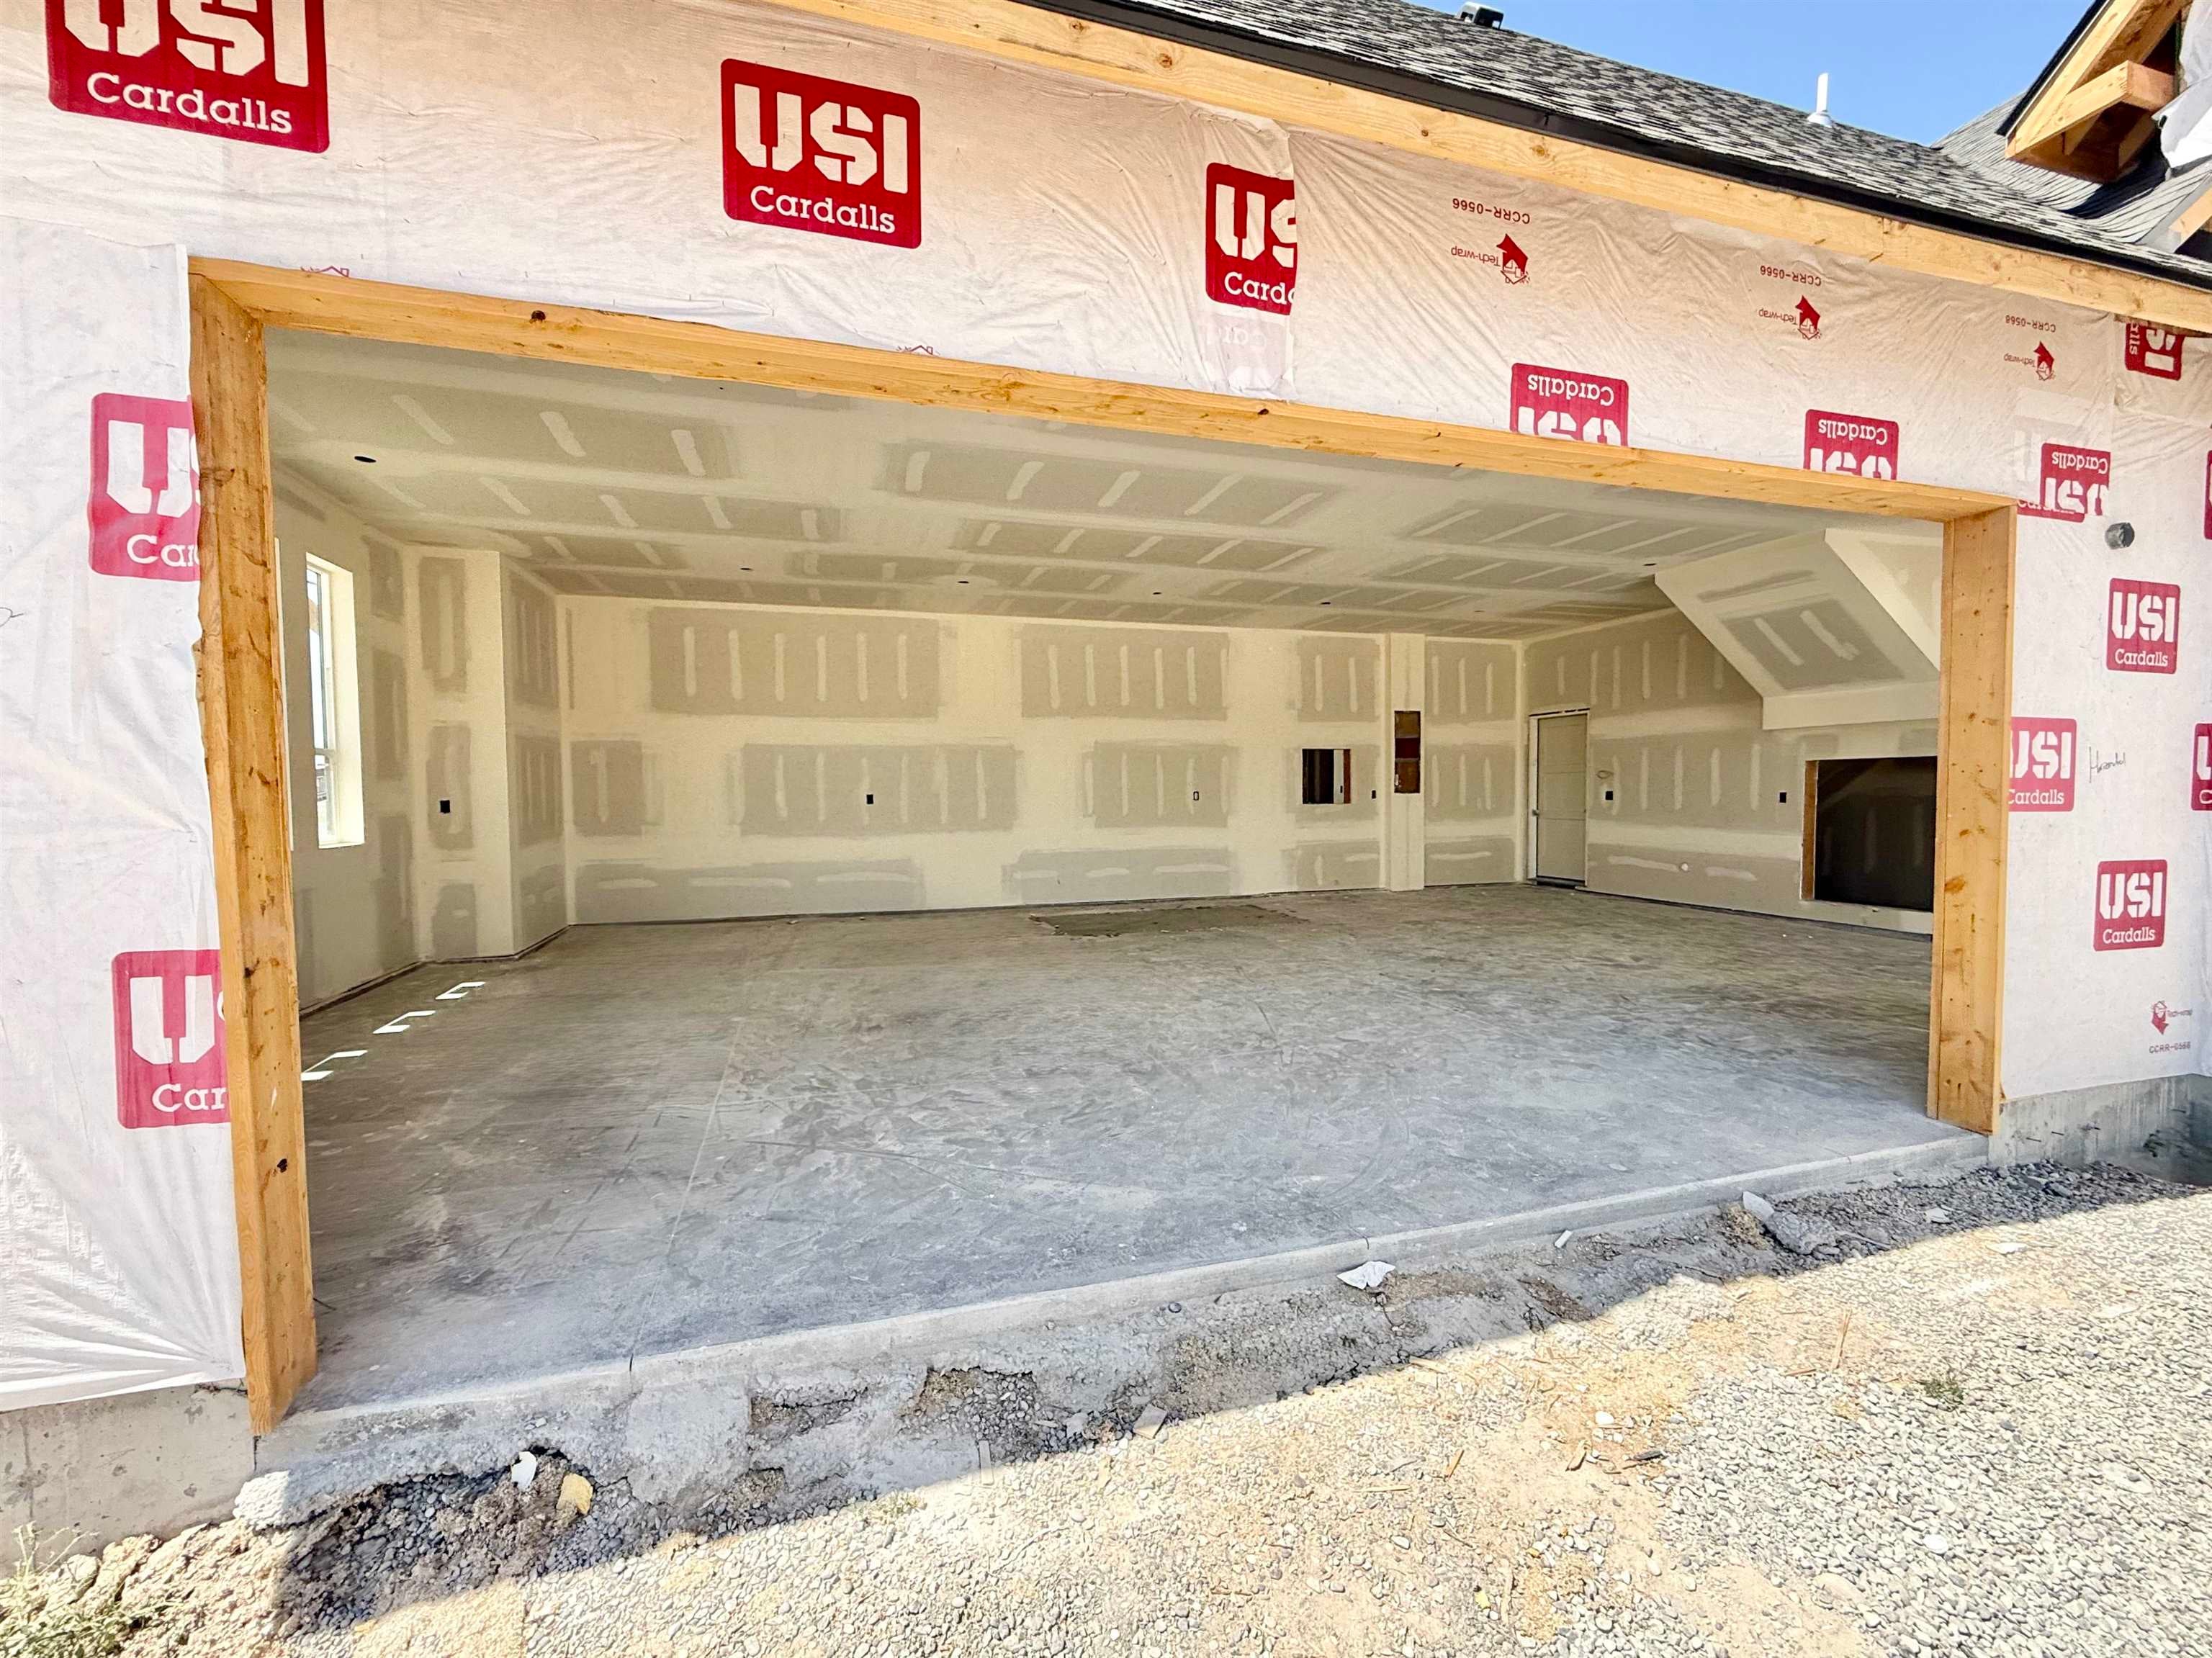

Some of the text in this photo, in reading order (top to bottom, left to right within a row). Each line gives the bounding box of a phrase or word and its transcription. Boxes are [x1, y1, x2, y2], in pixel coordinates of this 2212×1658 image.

[86, 71, 293, 135] Cardalls
[734, 82, 908, 194] USI
[750, 184, 896, 234] Cardalls
[1452, 198, 1531, 225] CCRR-0566
[1450, 245, 1501, 267] Tech-wrap
[1760, 265, 1822, 287] CCRR-0566
[1527, 373, 1614, 407] Cardalls
[1817, 418, 1889, 446] Cardalls
[2051, 451, 2108, 475] Cardalls
[2110, 590, 2177, 643] USI
[2114, 647, 2169, 667] Cardalls
[2098, 871, 2164, 920] USI
[2102, 926, 2156, 945] Cardalls
